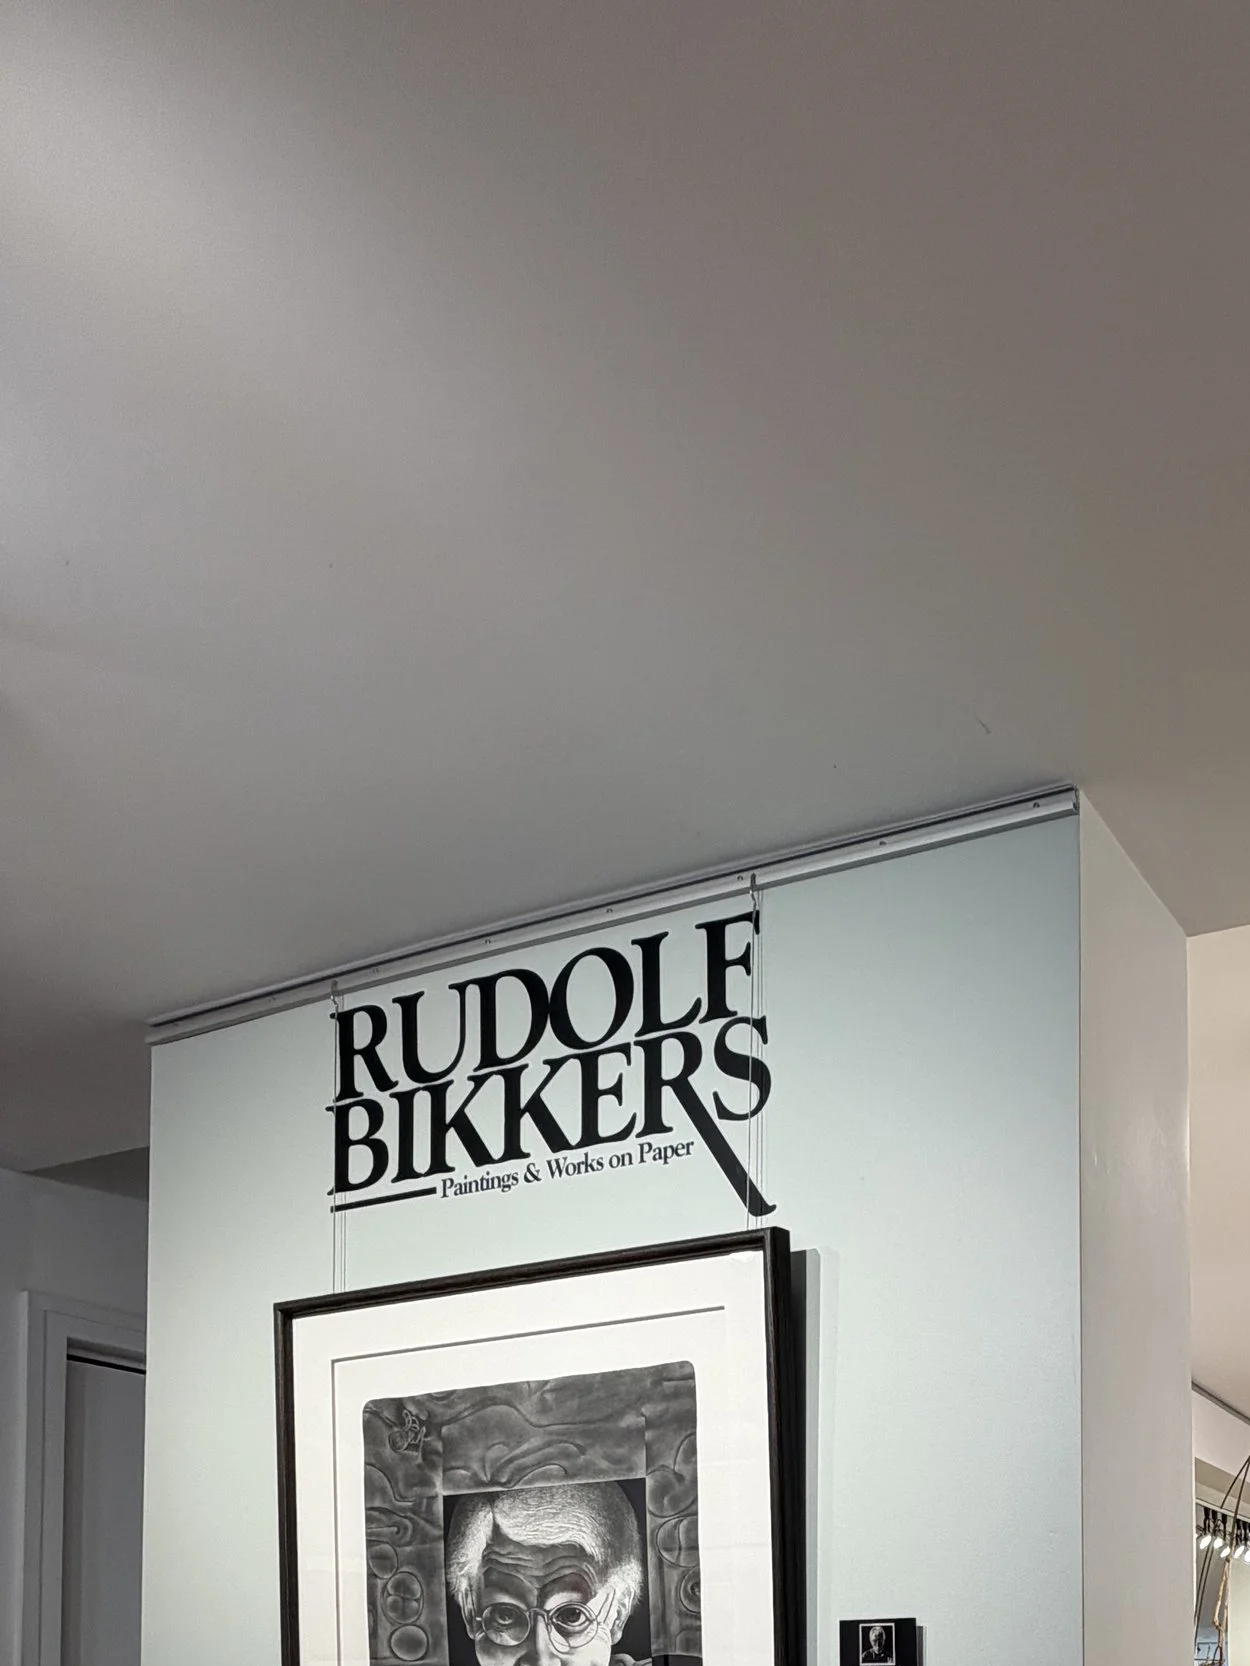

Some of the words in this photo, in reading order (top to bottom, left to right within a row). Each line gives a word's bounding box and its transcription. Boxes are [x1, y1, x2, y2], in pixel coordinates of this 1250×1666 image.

[330, 910, 760, 1102] RUDOLF
[325, 1015, 777, 1217] BIKKERS
[441, 1171, 519, 1199] Paintings
[523, 1162, 542, 1184] &
[546, 1152, 605, 1179] Works
[608, 1151, 633, 1169] on
[638, 1141, 695, 1166] Paper
